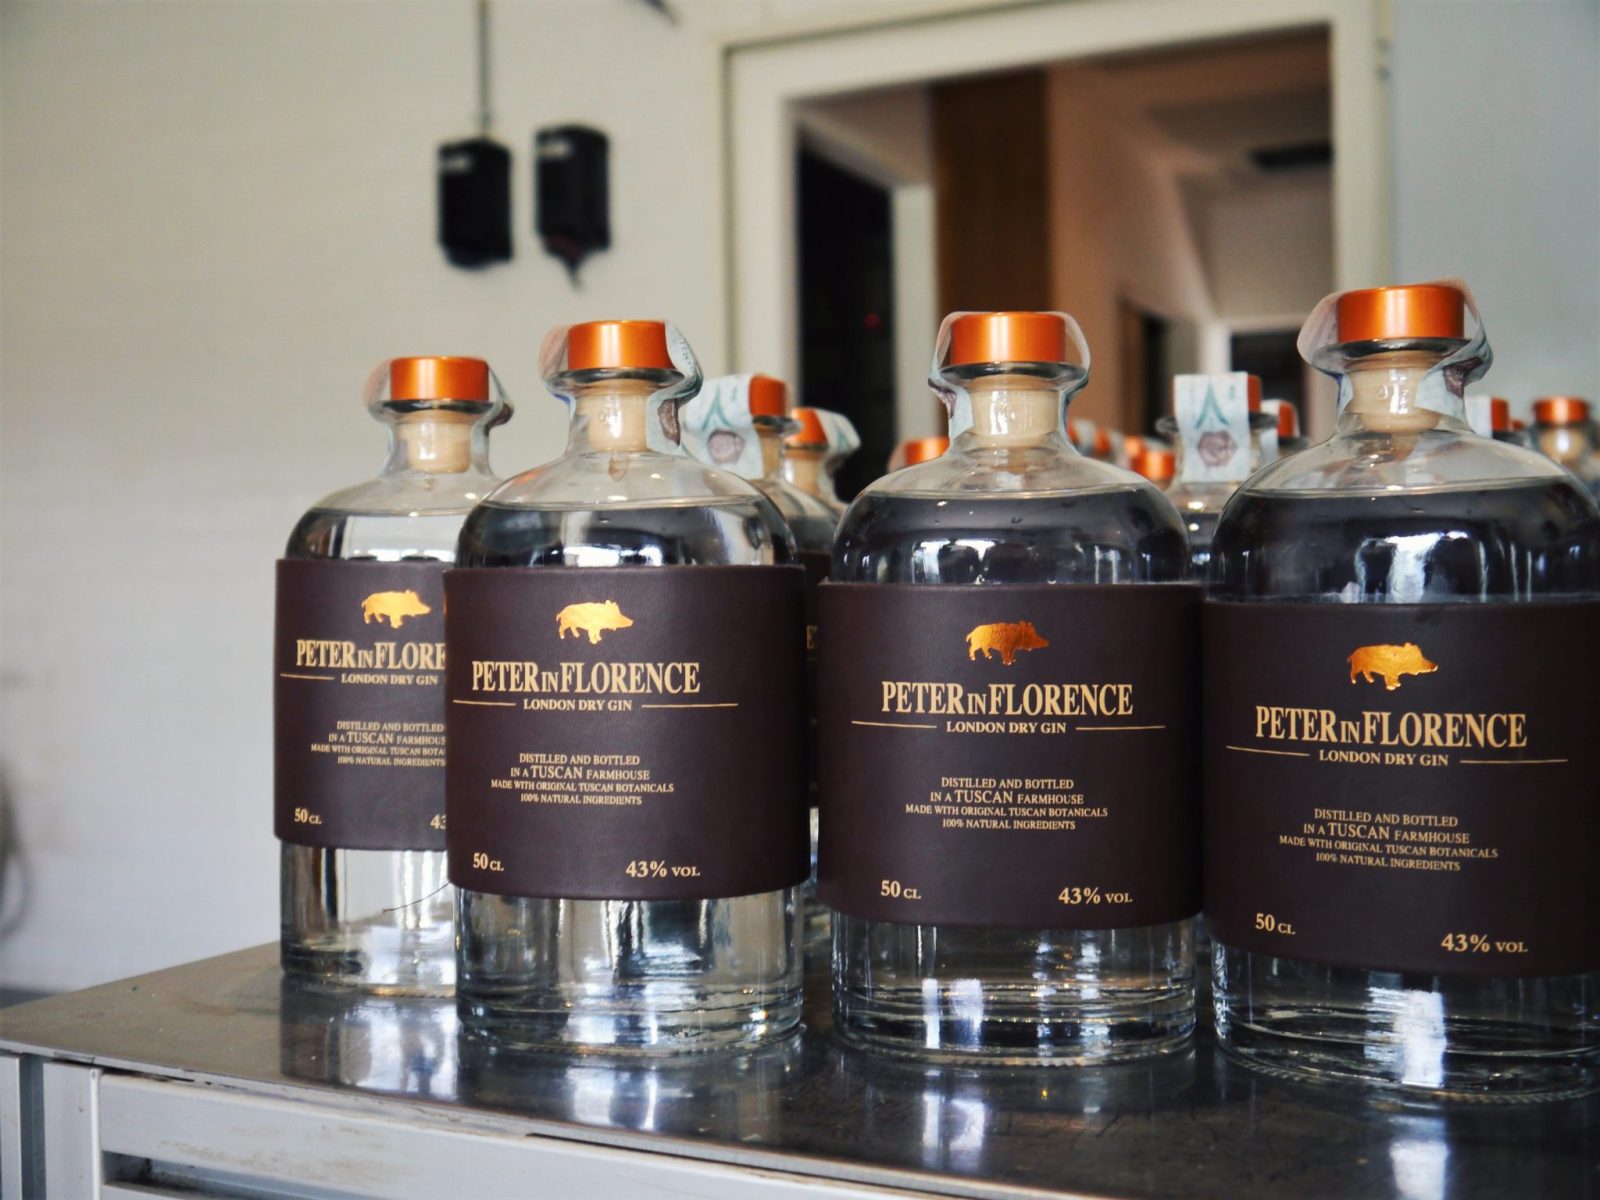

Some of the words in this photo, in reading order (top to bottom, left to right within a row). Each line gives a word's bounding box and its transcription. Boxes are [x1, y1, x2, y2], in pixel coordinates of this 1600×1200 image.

[296, 639, 356, 668] PETER
[341, 673, 387, 685] LONDON
[390, 674, 414, 685] DRY
[416, 675, 438, 685] GIN
[472, 661, 539, 692] PETER
[560, 662, 700, 694] FLORENCE
[523, 699, 576, 710] LONDON
[578, 699, 605, 711] DRY
[608, 700, 632, 711] GIN
[882, 681, 964, 714] PETER
[989, 683, 1133, 716] FLORENCE
[337, 721, 380, 731] DISTILLED
[382, 722, 400, 732] AND
[403, 723, 443, 732] BOTTLED
[947, 721, 1005, 733] LONDON
[1009, 722, 1038, 733] DRY
[1041, 722, 1066, 734] GIN
[1256, 705, 1338, 743] PETER
[1362, 711, 1527, 748] FLORENCE
[329, 734, 337, 742] IN
[339, 734, 345, 742] A
[347, 732, 393, 744] TUSCAN
[397, 736, 446, 745] FARMHOUS
[311, 744, 330, 753] MADE
[332, 745, 350, 753] WITH
[351, 746, 388, 755] ORIGINAL
[390, 747, 421, 756] TUSCAN
[1320, 749, 1381, 764] LONDON
[1385, 753, 1416, 766] DRY
[1420, 754, 1449, 766] GIN
[338, 756, 354, 765] 100%
[356, 757, 391, 766] NATURAL
[519, 753, 567, 764] DISTILLED
[570, 754, 591, 765] AND
[593, 754, 639, 766] BOTTLED
[511, 767, 520, 777] IN
[522, 768, 529, 777] A
[530, 766, 582, 779] TUSCAN
[587, 769, 649, 780] FARMHOUSE
[491, 779, 512, 789] MADE
[514, 780, 534, 790] WITH
[536, 781, 576, 792] ORIGINAL
[578, 782, 614, 792] TUSCAN
[616, 783, 674, 793] BOTANICALS
[941, 777, 996, 788] DISTILLED
[999, 778, 1023, 788] AND
[1025, 778, 1073, 789] BOTTLED
[521, 793, 539, 802] 100%
[541, 793, 581, 804] NATURAL
[583, 795, 642, 805] INGREDIENTS
[930, 792, 941, 802] IN
[945, 792, 952, 802] A
[954, 790, 1013, 803] TUSCAN
[1018, 794, 1084, 805] FARMHOUSE
[294, 808, 307, 822] 50
[906, 804, 932, 815] MADE
[934, 805, 959, 816] WITH
[961, 806, 1007, 816] ORIGINAL
[1009, 807, 1046, 817] TUSCAN
[1049, 808, 1108, 818] BOTANICALS
[1314, 808, 1371, 822] DISTILLED
[1375, 813, 1399, 824] AND
[1403, 814, 1458, 827] BOTTLED
[942, 819, 964, 828] 100%
[966, 819, 1011, 829] NATURAL
[1013, 820, 1076, 830] INGREDIENTS
[1304, 824, 1315, 834] IN
[1318, 825, 1325, 835] A
[1327, 822, 1390, 839] TUSCAN
[1395, 829, 1469, 844] FARMHOUSE
[1279, 835, 1306, 846] MADE
[1308, 837, 1333, 849] WITH
[1334, 840, 1383, 853] ORIGINAL
[1386, 844, 1427, 856] TUSCAN
[1429, 846, 1498, 858] BOTANICALS
[473, 852, 488, 869] 50
[1316, 852, 1338, 863] 100%
[1340, 854, 1388, 867] NATURAL
[1391, 857, 1460, 871] INGREDIENTS
[626, 861, 667, 877] 43%
[880, 880, 900, 898] 50
[1058, 888, 1101, 904] 43%
[1255, 912, 1275, 932] 50
[1441, 933, 1490, 952] 43%
